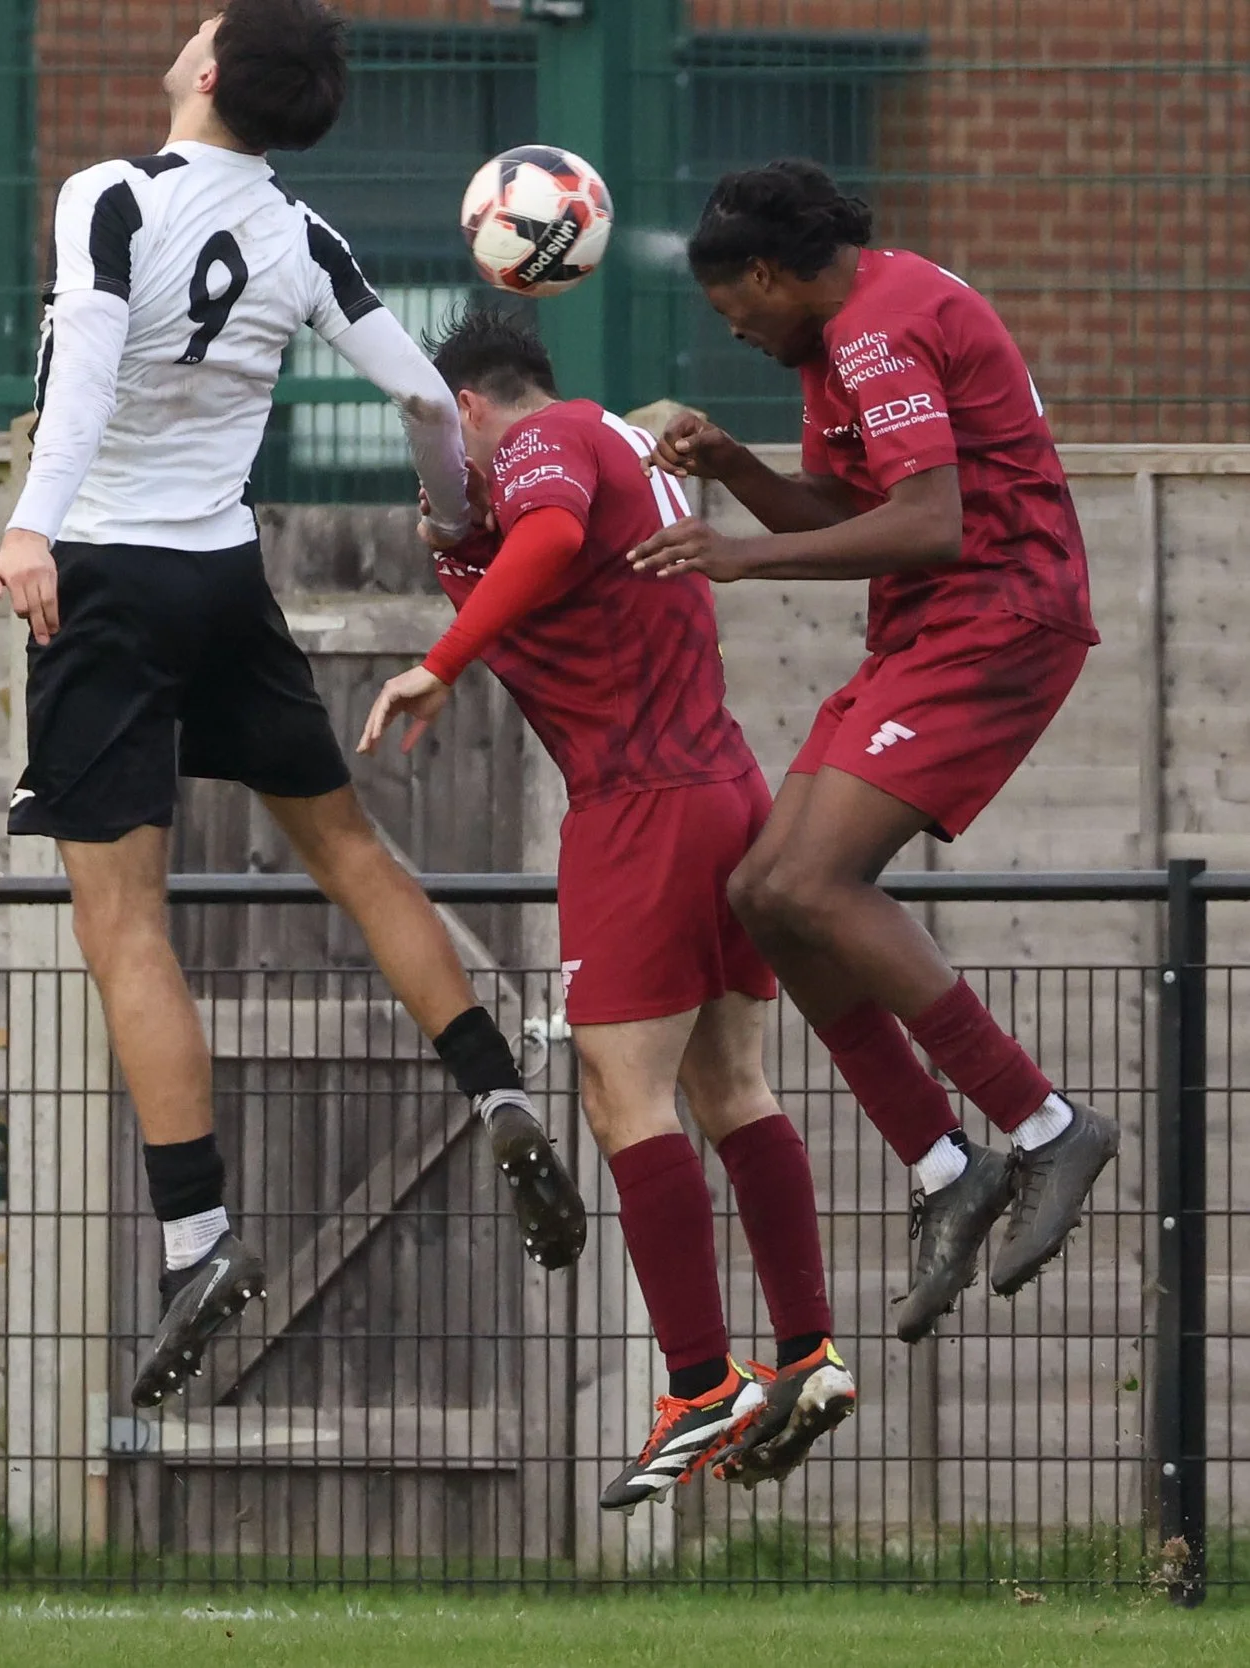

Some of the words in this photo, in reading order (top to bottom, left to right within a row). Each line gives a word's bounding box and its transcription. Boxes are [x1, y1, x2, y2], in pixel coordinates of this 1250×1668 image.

[518, 220, 577, 282] uhlsport
[173, 230, 249, 364] 9
[835, 331, 888, 366] Charles
[838, 342, 889, 379] Russell
[843, 356, 916, 394] Speechlys
[864, 393, 933, 428] EDR
[871, 420, 911, 438] Enterprise
[504, 465, 564, 497] EDR
